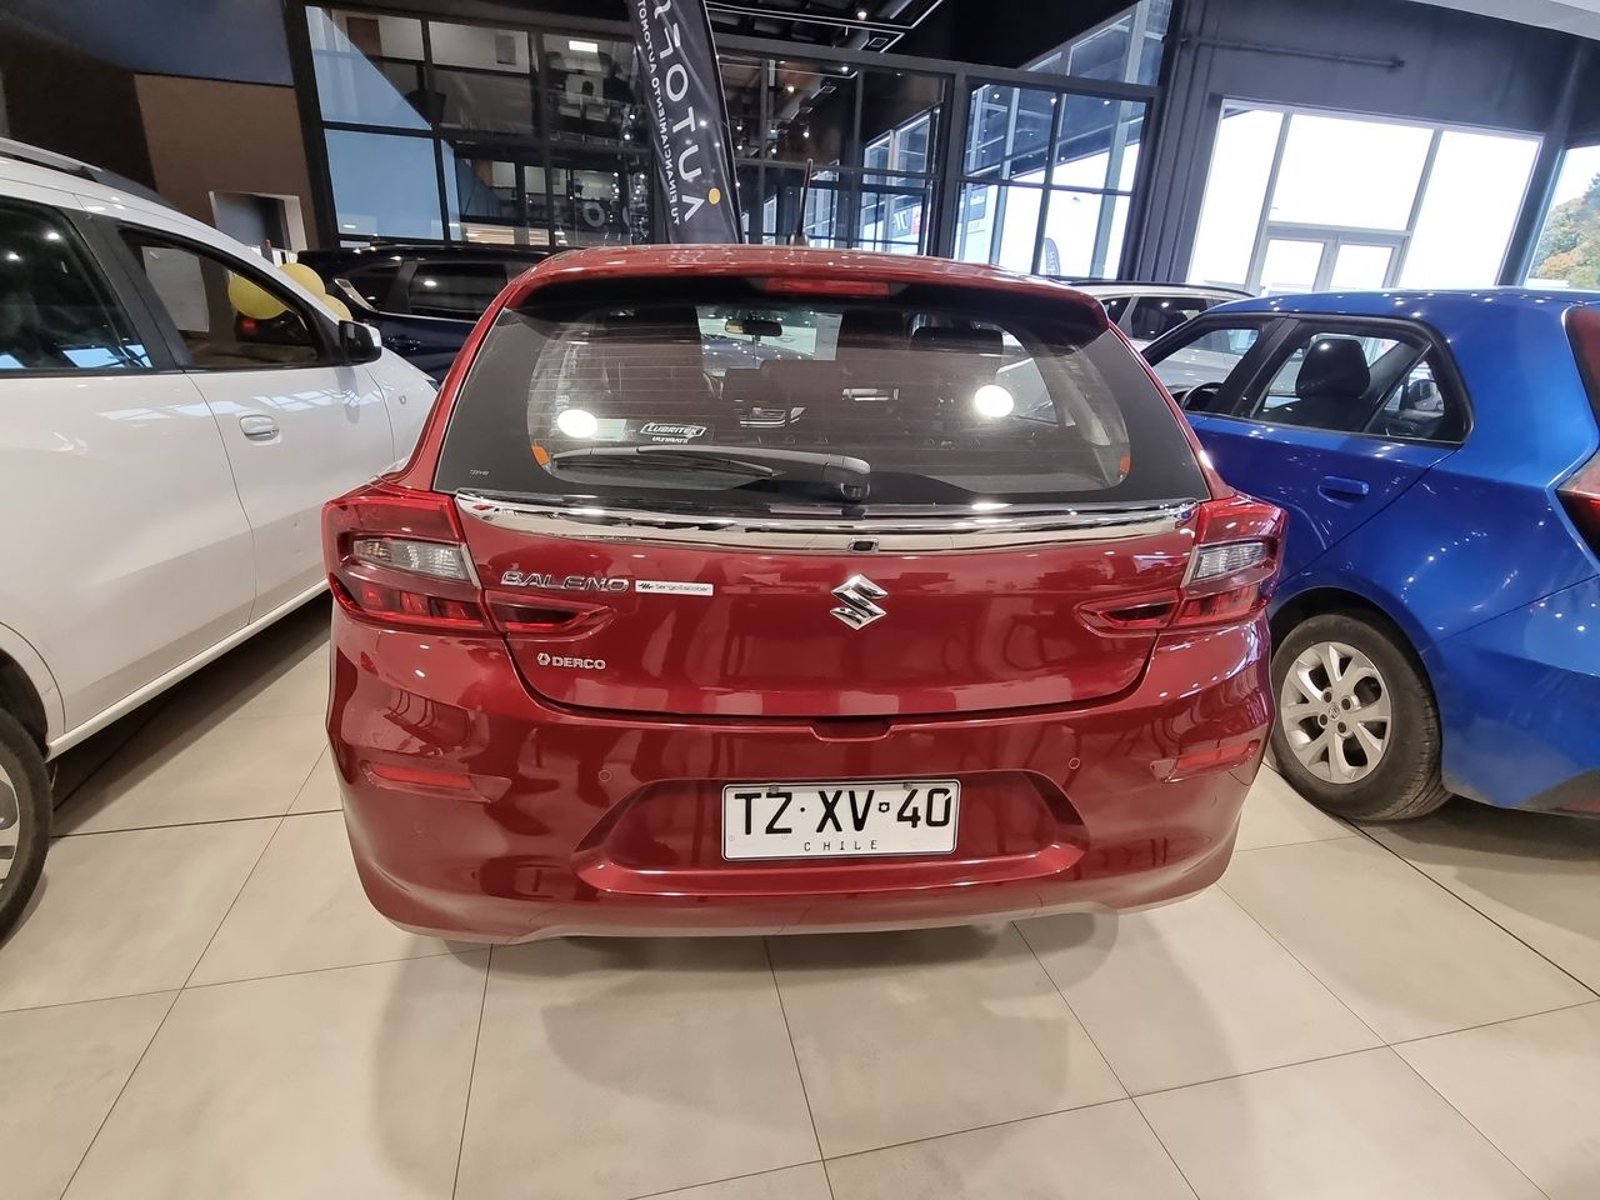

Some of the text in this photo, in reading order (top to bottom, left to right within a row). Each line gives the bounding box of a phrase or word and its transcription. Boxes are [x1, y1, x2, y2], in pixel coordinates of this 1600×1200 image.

[647, 423, 699, 437] LUBRITEK
[501, 570, 630, 591] BALENO
[552, 656, 606, 670] DERCO
[804, 840, 878, 852] CHILE
